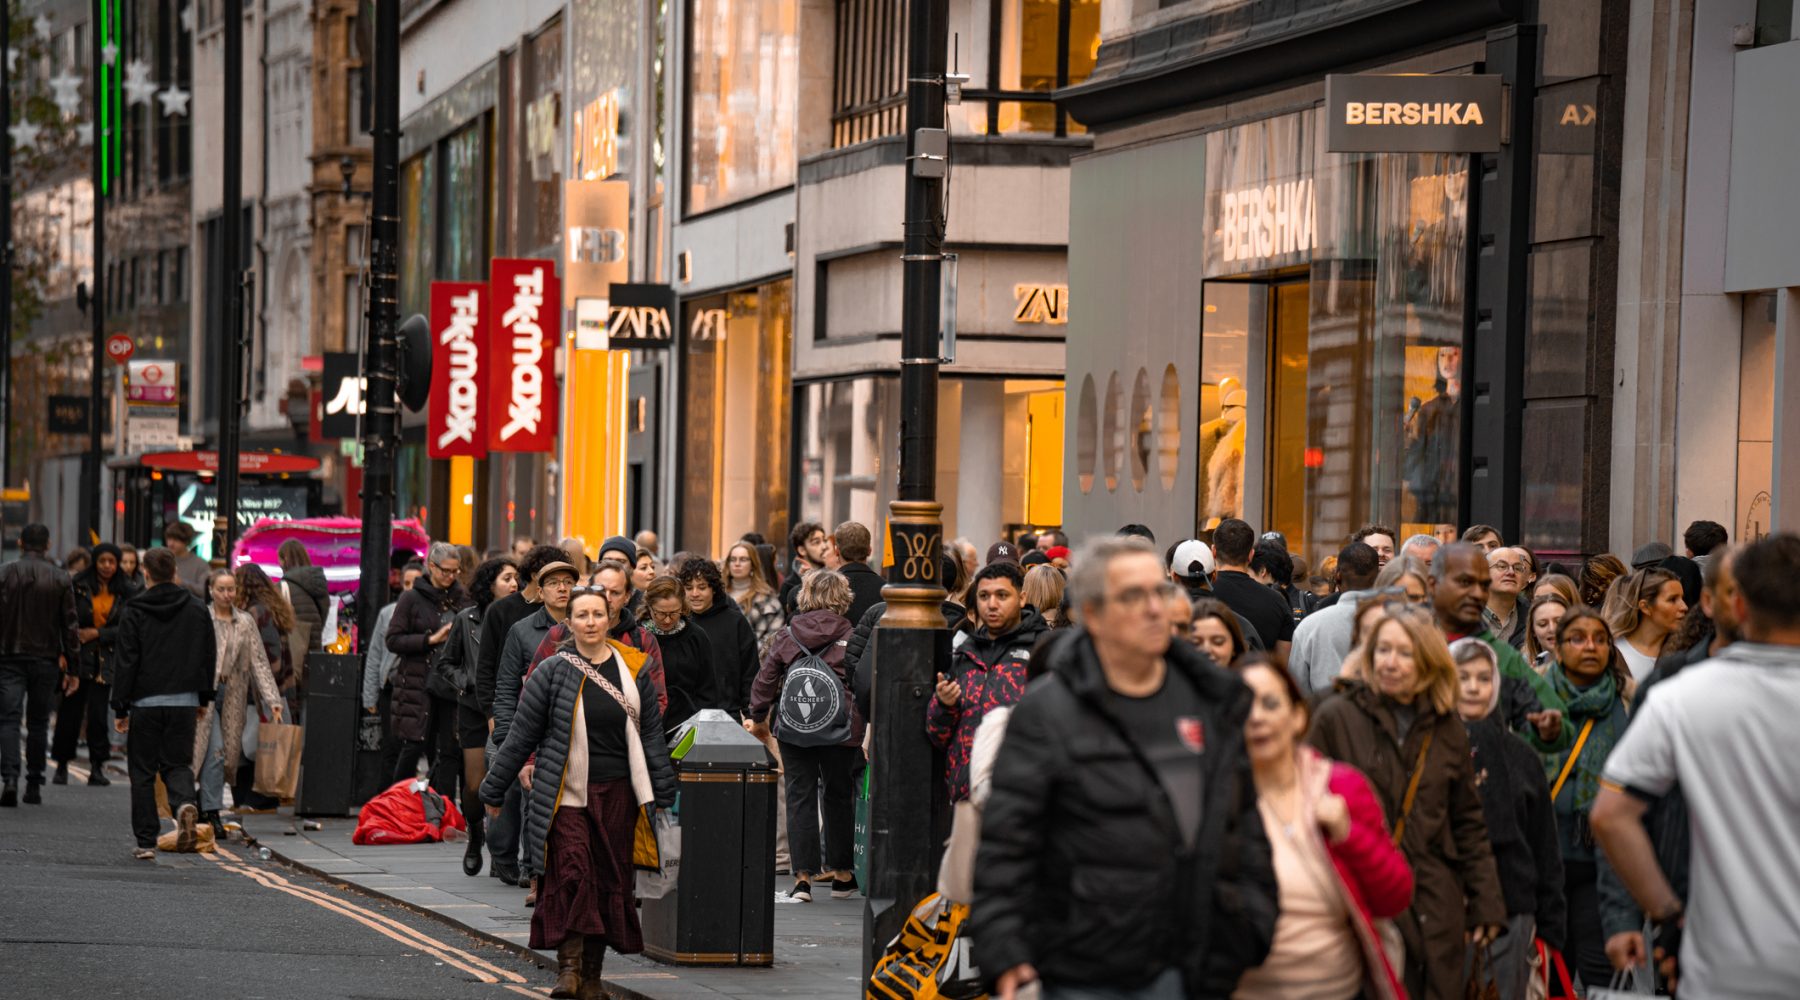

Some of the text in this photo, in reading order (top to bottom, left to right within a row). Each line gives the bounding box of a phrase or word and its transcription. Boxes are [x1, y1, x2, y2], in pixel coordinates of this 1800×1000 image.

[1345, 102, 1483, 125] BERSHKA
[1223, 178, 1318, 262] BERSHKA
[609, 306, 672, 339] ZARA
[790, 695, 825, 703] SKECHERS
